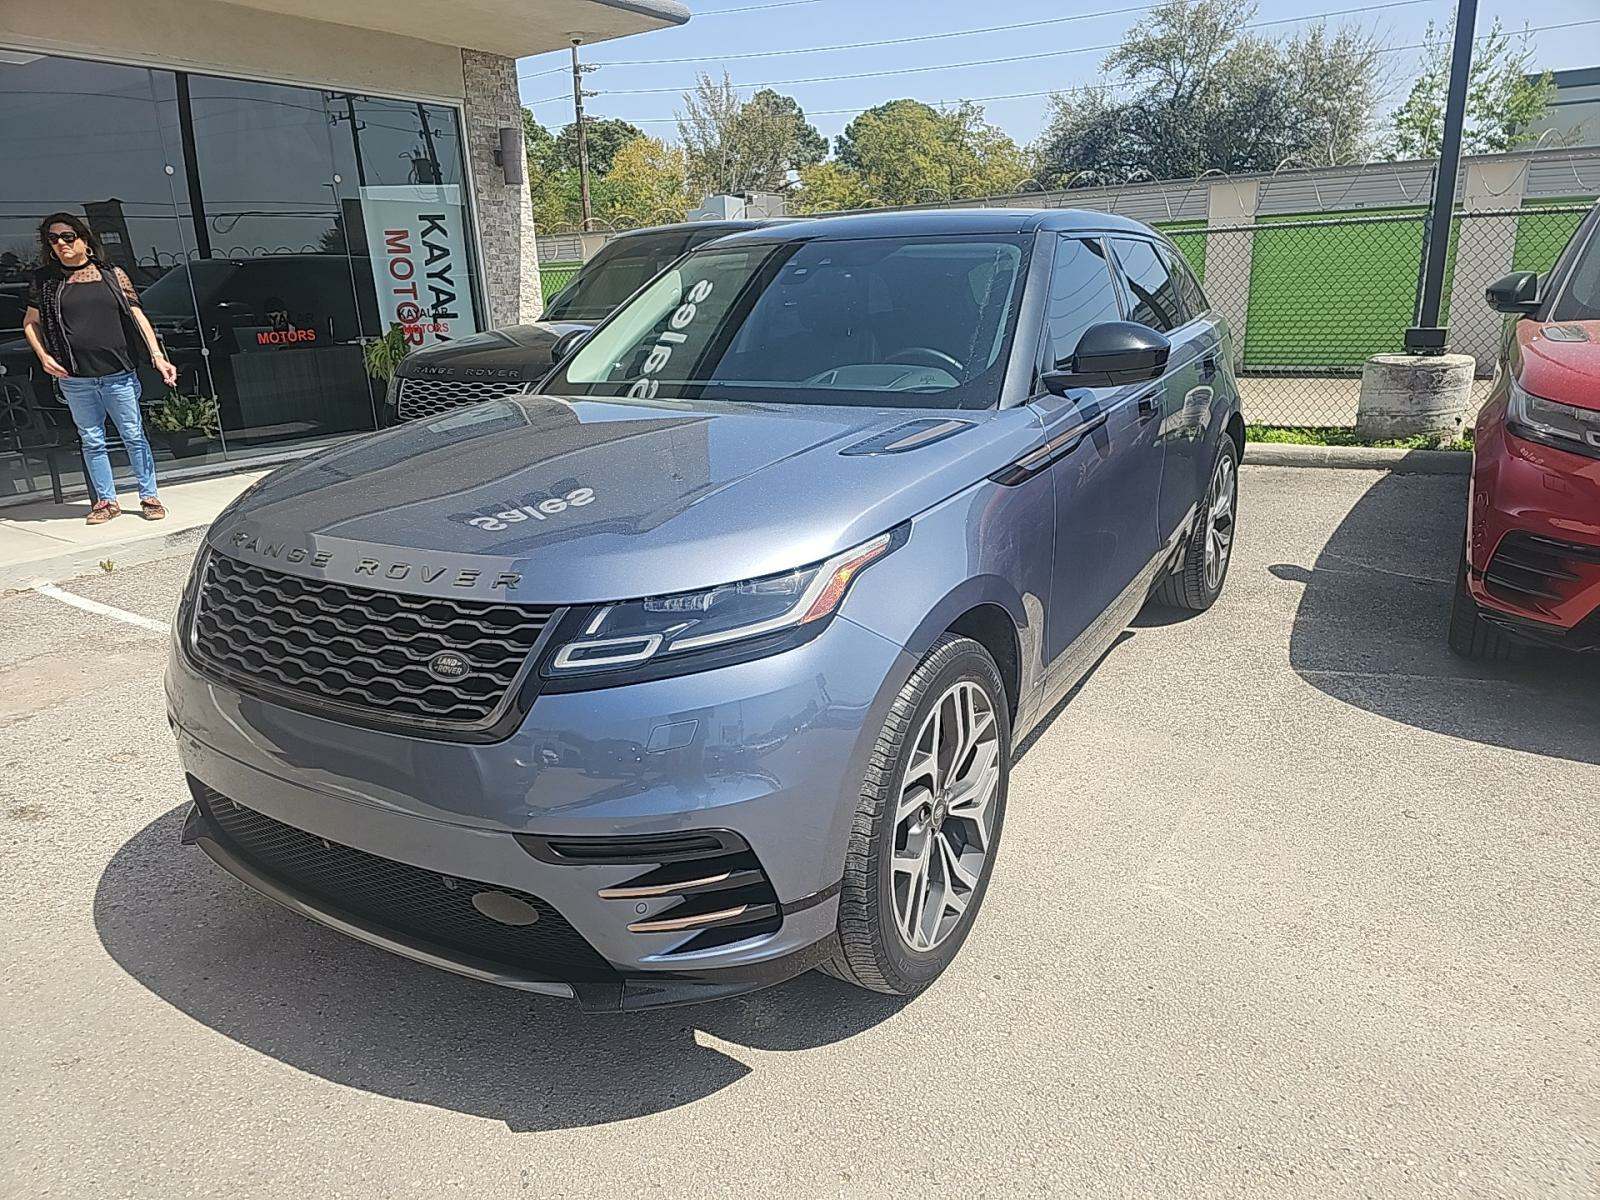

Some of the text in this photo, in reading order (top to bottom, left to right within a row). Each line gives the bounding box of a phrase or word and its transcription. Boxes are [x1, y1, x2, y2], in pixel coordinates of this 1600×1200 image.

[256, 329, 316, 344] MOTORS
[413, 365, 521, 378] RANGE ROVER
[229, 530, 523, 591] RANGE ROVER
[437, 656, 458, 666] LAND
[437, 664, 463, 675] ROVER
